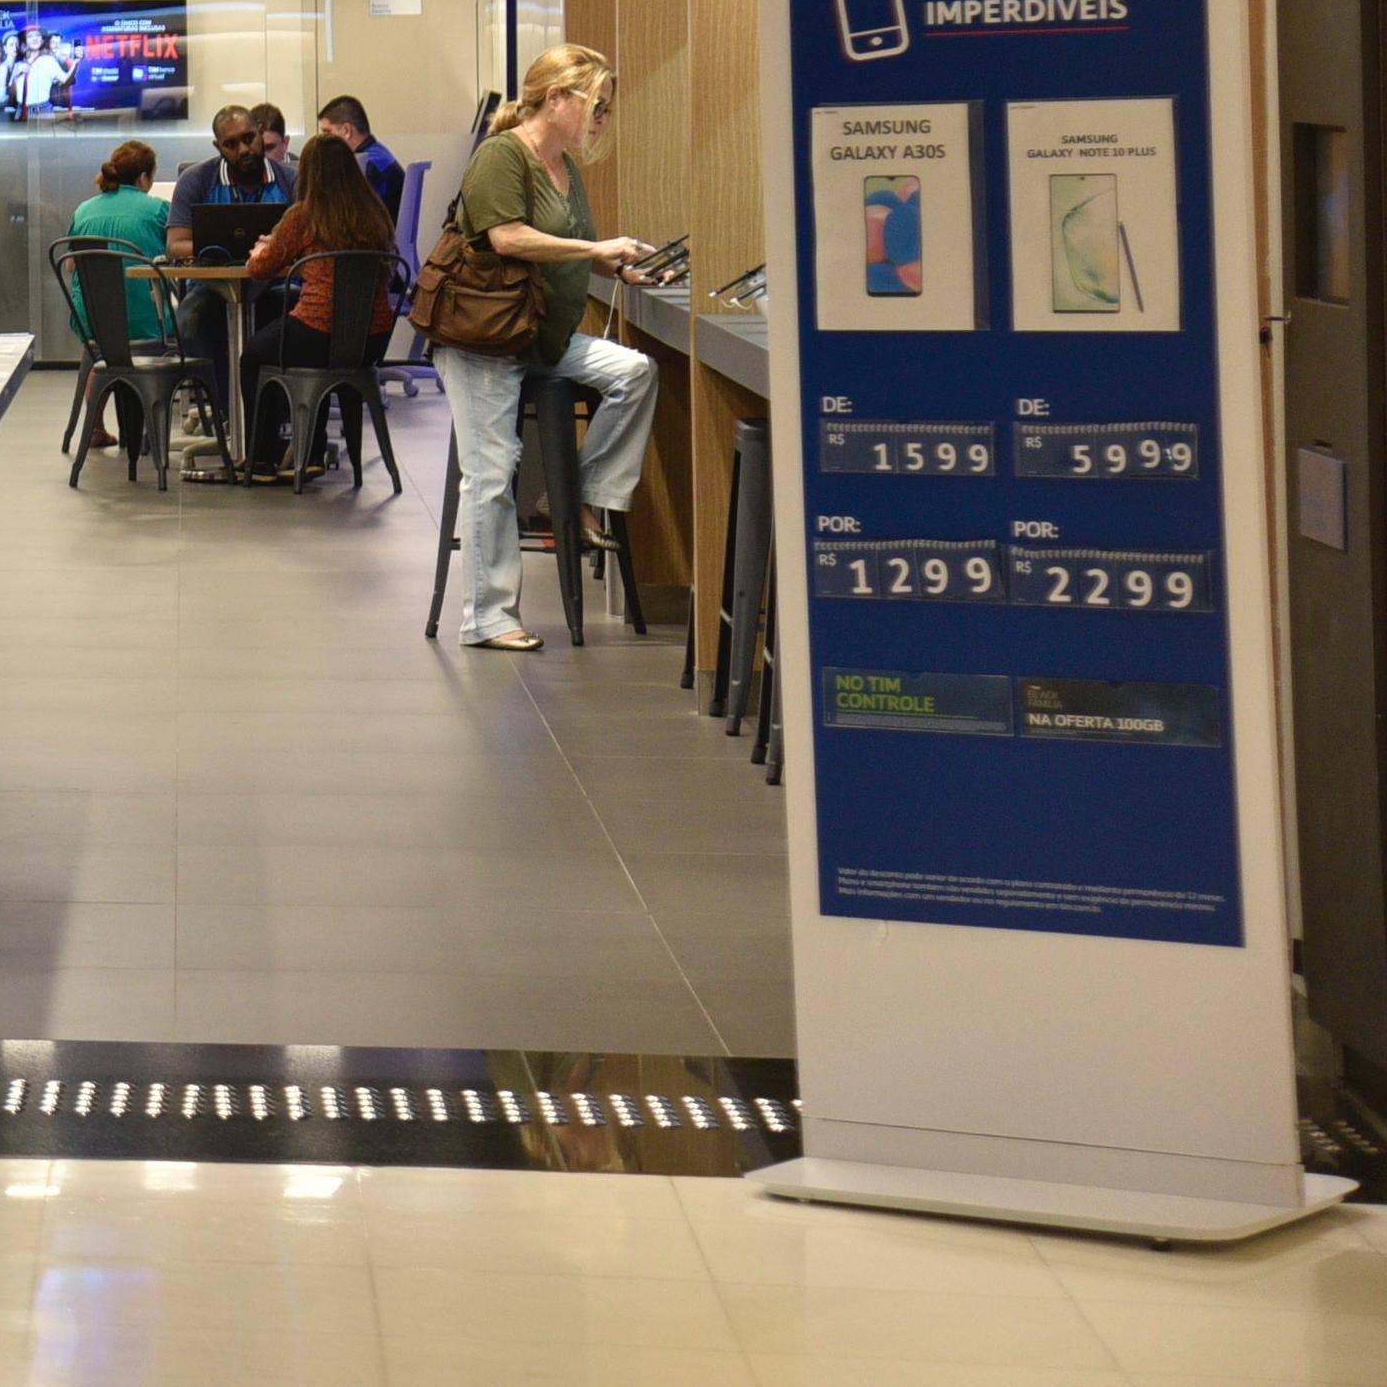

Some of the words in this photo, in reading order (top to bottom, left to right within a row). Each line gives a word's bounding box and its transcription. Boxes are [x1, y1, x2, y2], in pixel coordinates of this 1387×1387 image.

[86, 34, 179, 61] NETFLIX
[842, 119, 931, 136] SAMSUNG
[1061, 134, 1118, 144] SAMSUNG
[830, 145, 897, 161] GALAXY
[902, 143, 945, 160] A30S
[1027, 148, 1073, 159] GALAXY
[1079, 147, 1111, 157] NOTE
[1112, 147, 1125, 157] 10
[1128, 146, 1157, 157] PLUS
[822, 396, 852, 414] DE:
[1018, 398, 1050, 415] DE:
[828, 433, 844, 446] R$
[873, 441, 989, 471] 1599
[1025, 436, 1042, 449] R$
[1072, 439, 1192, 472] 5999
[818, 515, 861, 534] POR:
[1013, 520, 1059, 539] POR:
[819, 553, 836, 567] R$
[848, 556, 993, 595] 1299
[1015, 560, 1032, 574] R$
[1046, 566, 1194, 608] 2299
[836, 675, 865, 692] NO
[870, 677, 902, 694] TIM
[836, 693, 935, 714] CONTROLE
[1029, 713, 1052, 726] NA
[1054, 714, 1114, 729] OFERTA
[1117, 717, 1165, 732] 100GB
